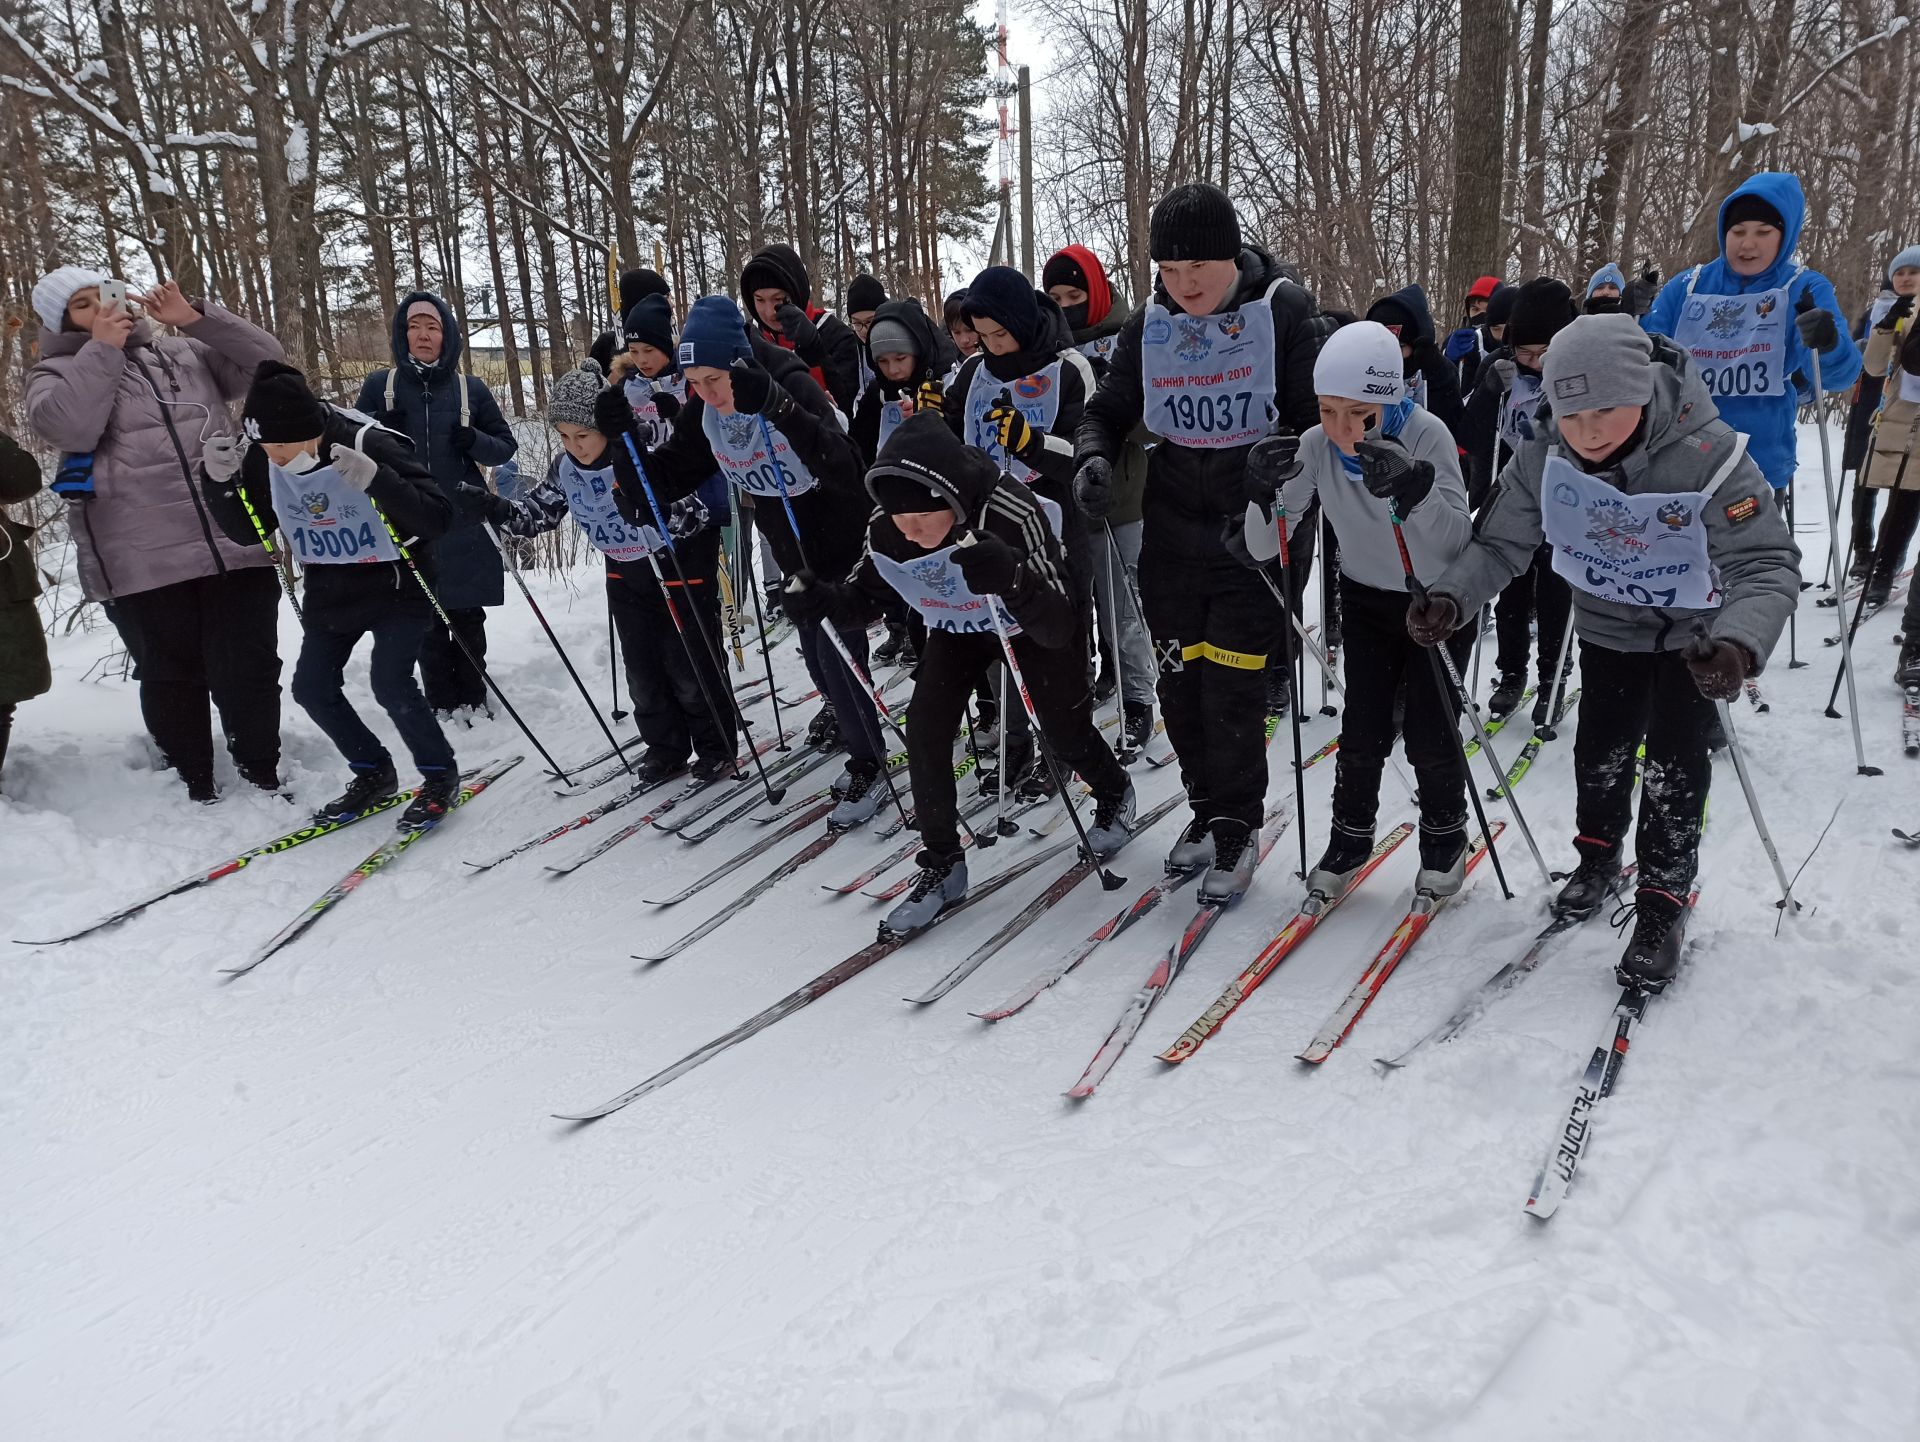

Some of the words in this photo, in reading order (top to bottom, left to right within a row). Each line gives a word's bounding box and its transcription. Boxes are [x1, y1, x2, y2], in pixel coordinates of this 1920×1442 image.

[1152, 375, 1185, 388] ЛЫЖНЯ
[1188, 373, 1224, 387] РОССИИ
[1227, 365, 1252, 381] 2010
[1701, 360, 1770, 396] 9003
[1163, 391, 1253, 432] 19037
[293, 521, 376, 558] 19004
[1624, 537, 1650, 551] 2017
[1214, 650, 1241, 665] WHITE
[1553, 1084, 1597, 1183] PELTONEN
